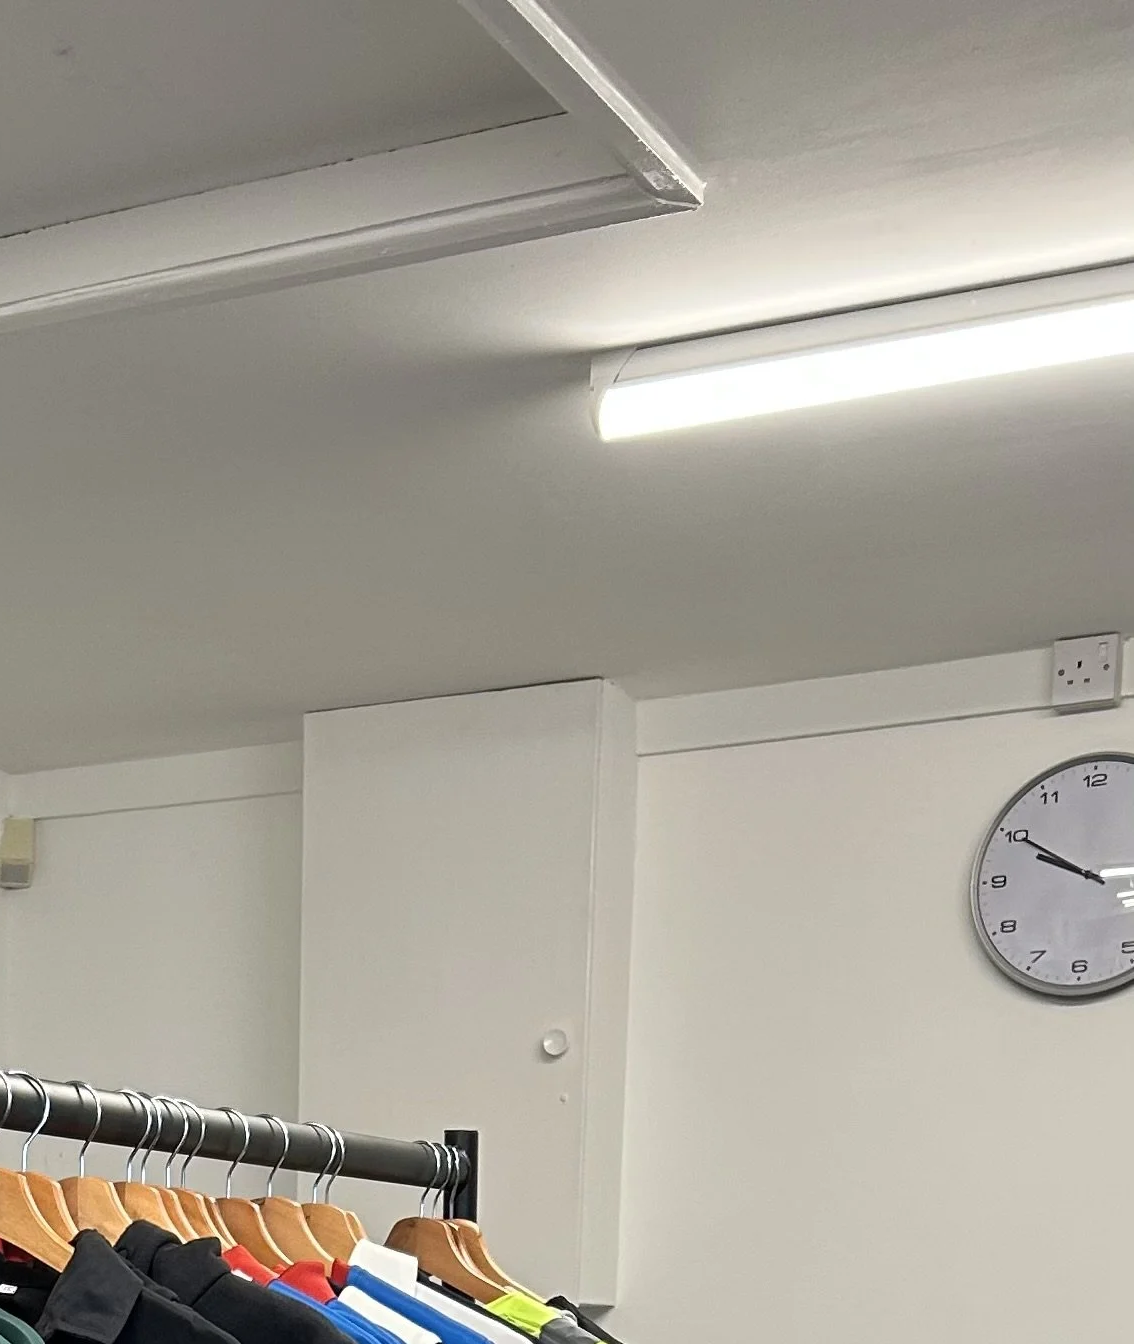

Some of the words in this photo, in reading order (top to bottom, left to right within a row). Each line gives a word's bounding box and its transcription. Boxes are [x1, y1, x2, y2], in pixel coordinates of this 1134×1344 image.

[1082, 773, 1108, 788] 12
[1040, 790, 1059, 804] 11
[1004, 829, 1029, 843] 10
[991, 875, 1007, 888] 9
[1000, 920, 1017, 933] 8
[1121, 941, 1134, 953] 5
[1030, 950, 1047, 963] 7
[1071, 959, 1088, 973] 6
